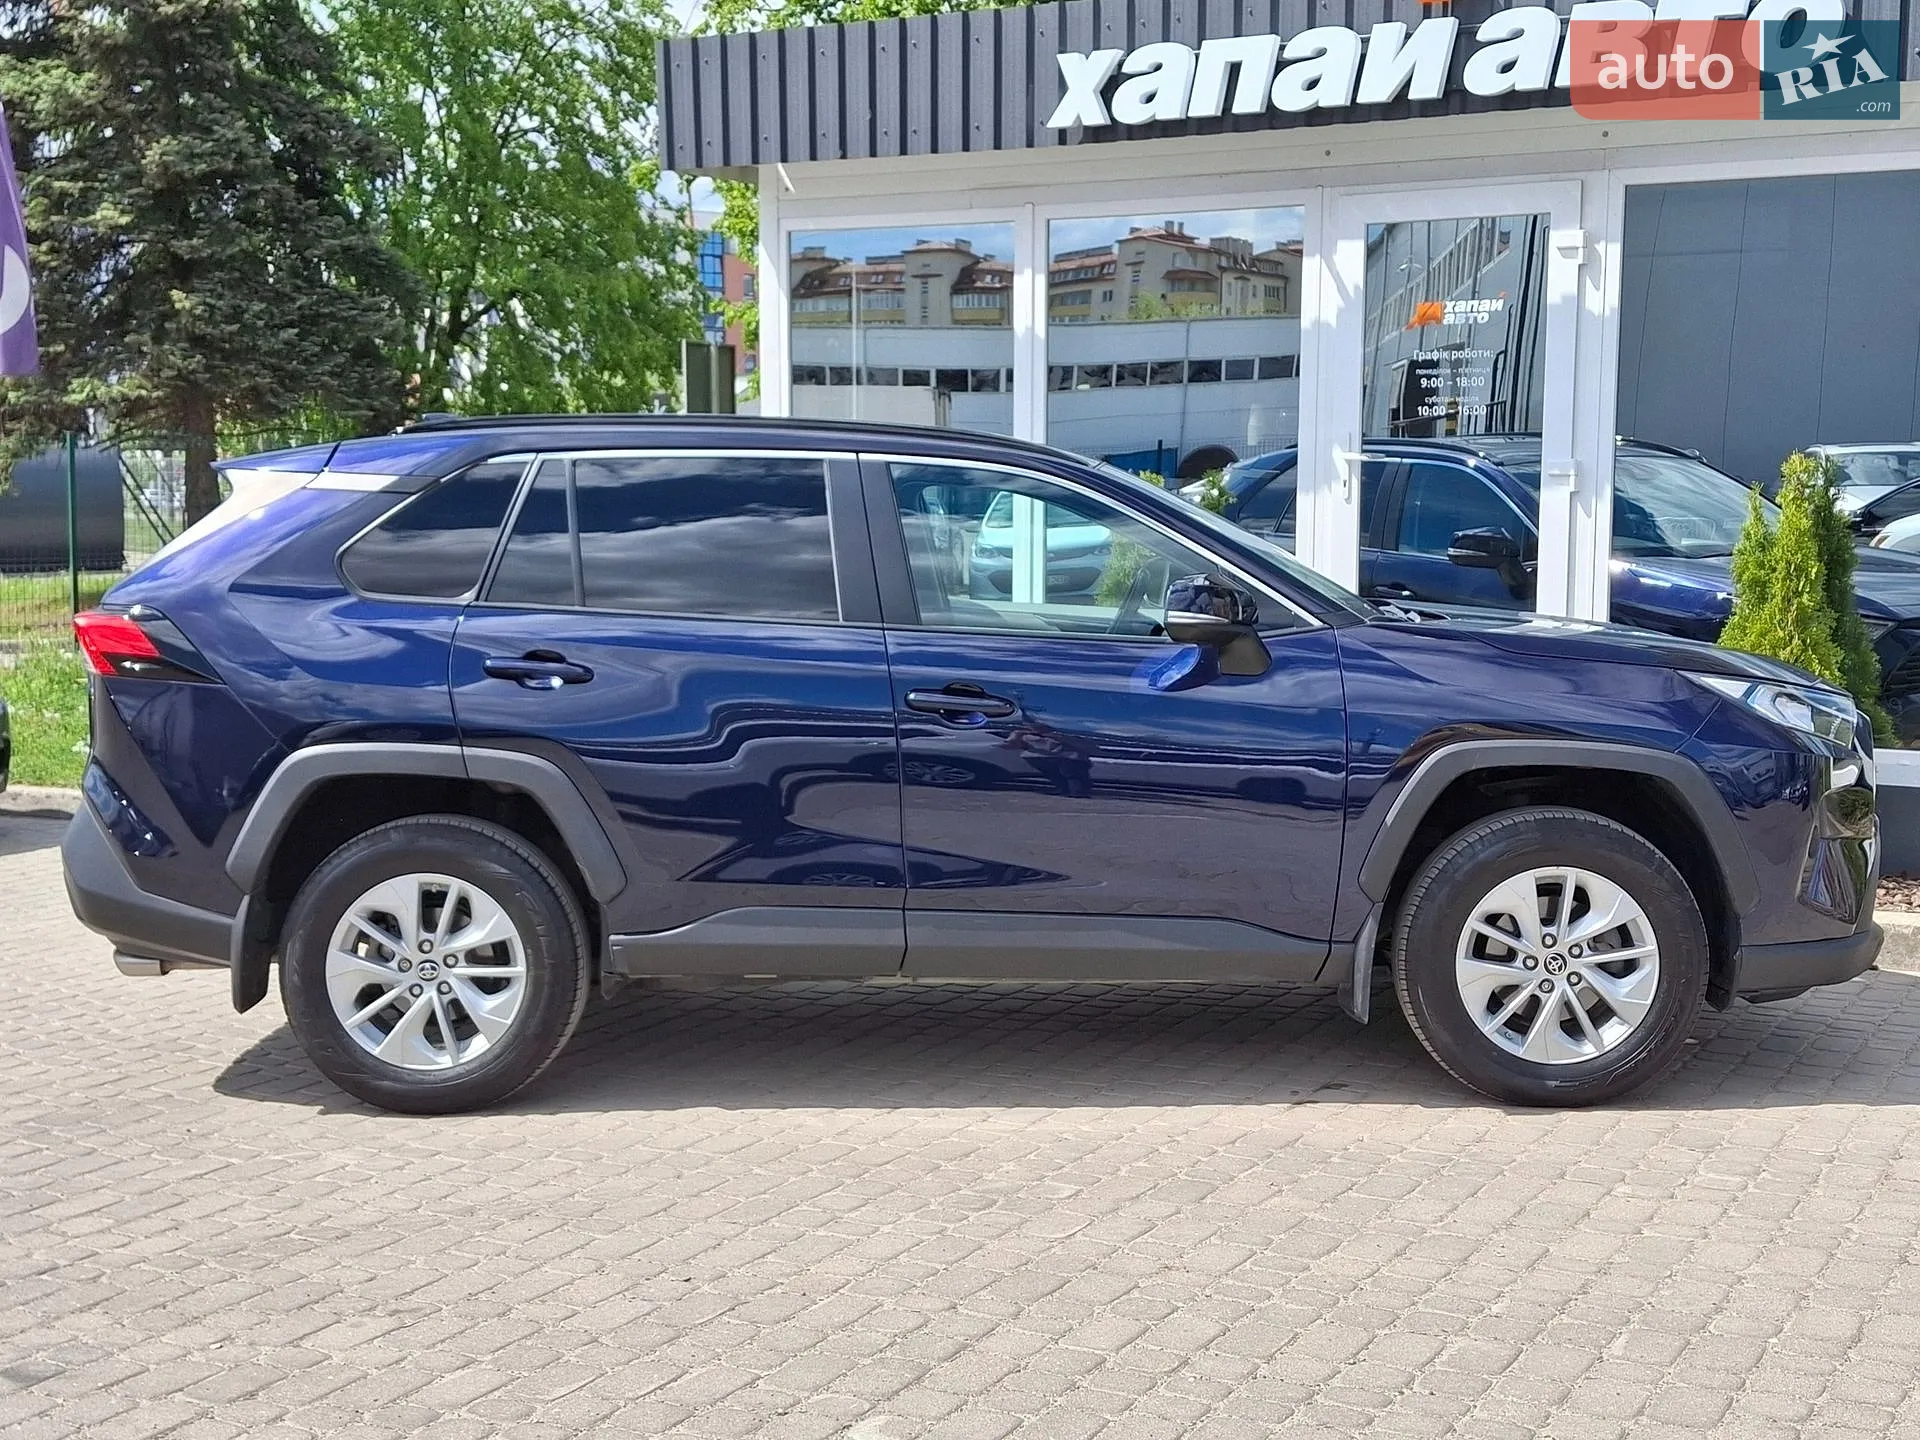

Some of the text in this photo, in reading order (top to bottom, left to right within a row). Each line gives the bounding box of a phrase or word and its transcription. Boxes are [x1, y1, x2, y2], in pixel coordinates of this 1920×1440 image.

[1443, 312, 1489, 324] авто
[1413, 348, 1494, 361] Графік роботи:
[1420, 376, 1444, 388] 9:00
[1455, 376, 1485, 387] 18:00
[1417, 405, 1446, 416] 10:00
[1457, 404, 1487, 415] 16:00
